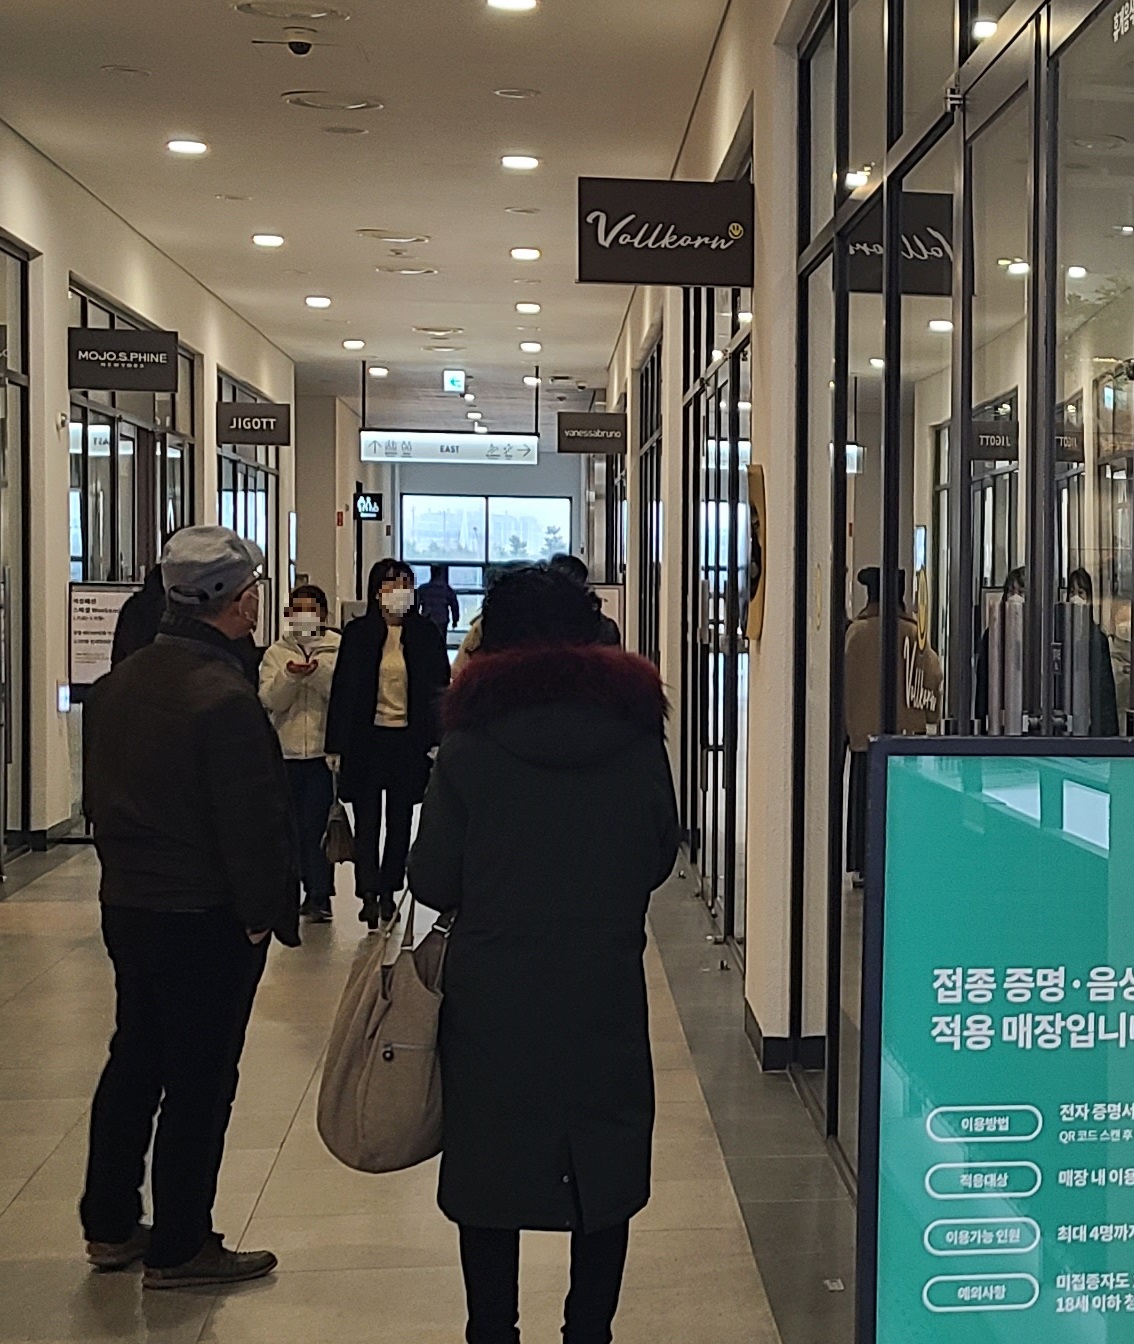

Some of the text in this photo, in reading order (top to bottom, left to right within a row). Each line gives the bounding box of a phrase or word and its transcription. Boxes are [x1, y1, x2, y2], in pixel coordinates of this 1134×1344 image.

[586, 211, 734, 249] Vollkorn
[229, 417, 277, 431] JIGOTT
[564, 429, 621, 438] vanessabruno
[440, 445, 460, 454] EAST
[903, 636, 937, 712] Vollkorn
[932, 967, 997, 1004] 접종
[931, 1013, 995, 1050] 적용
[1059, 1103, 1090, 1122] 전자
[961, 1116, 1010, 1132] 이용방법
[1059, 1130, 1076, 1144] QR
[1077, 1130, 1098, 1141] 코드
[1100, 1129, 1121, 1141] 스캔
[1122, 1129, 1133, 1141] 후
[959, 1172, 1009, 1188] 적용대상
[1058, 1169, 1089, 1187] 매장
[1091, 1168, 1106, 1186] 내
[1057, 1225, 1087, 1243] 최대
[1056, 1272, 1130, 1291] 미접종자도
[957, 1285, 1007, 1301] 예외사항
[1056, 1294, 1089, 1313] 18세
[1092, 1294, 1121, 1312] 이하
